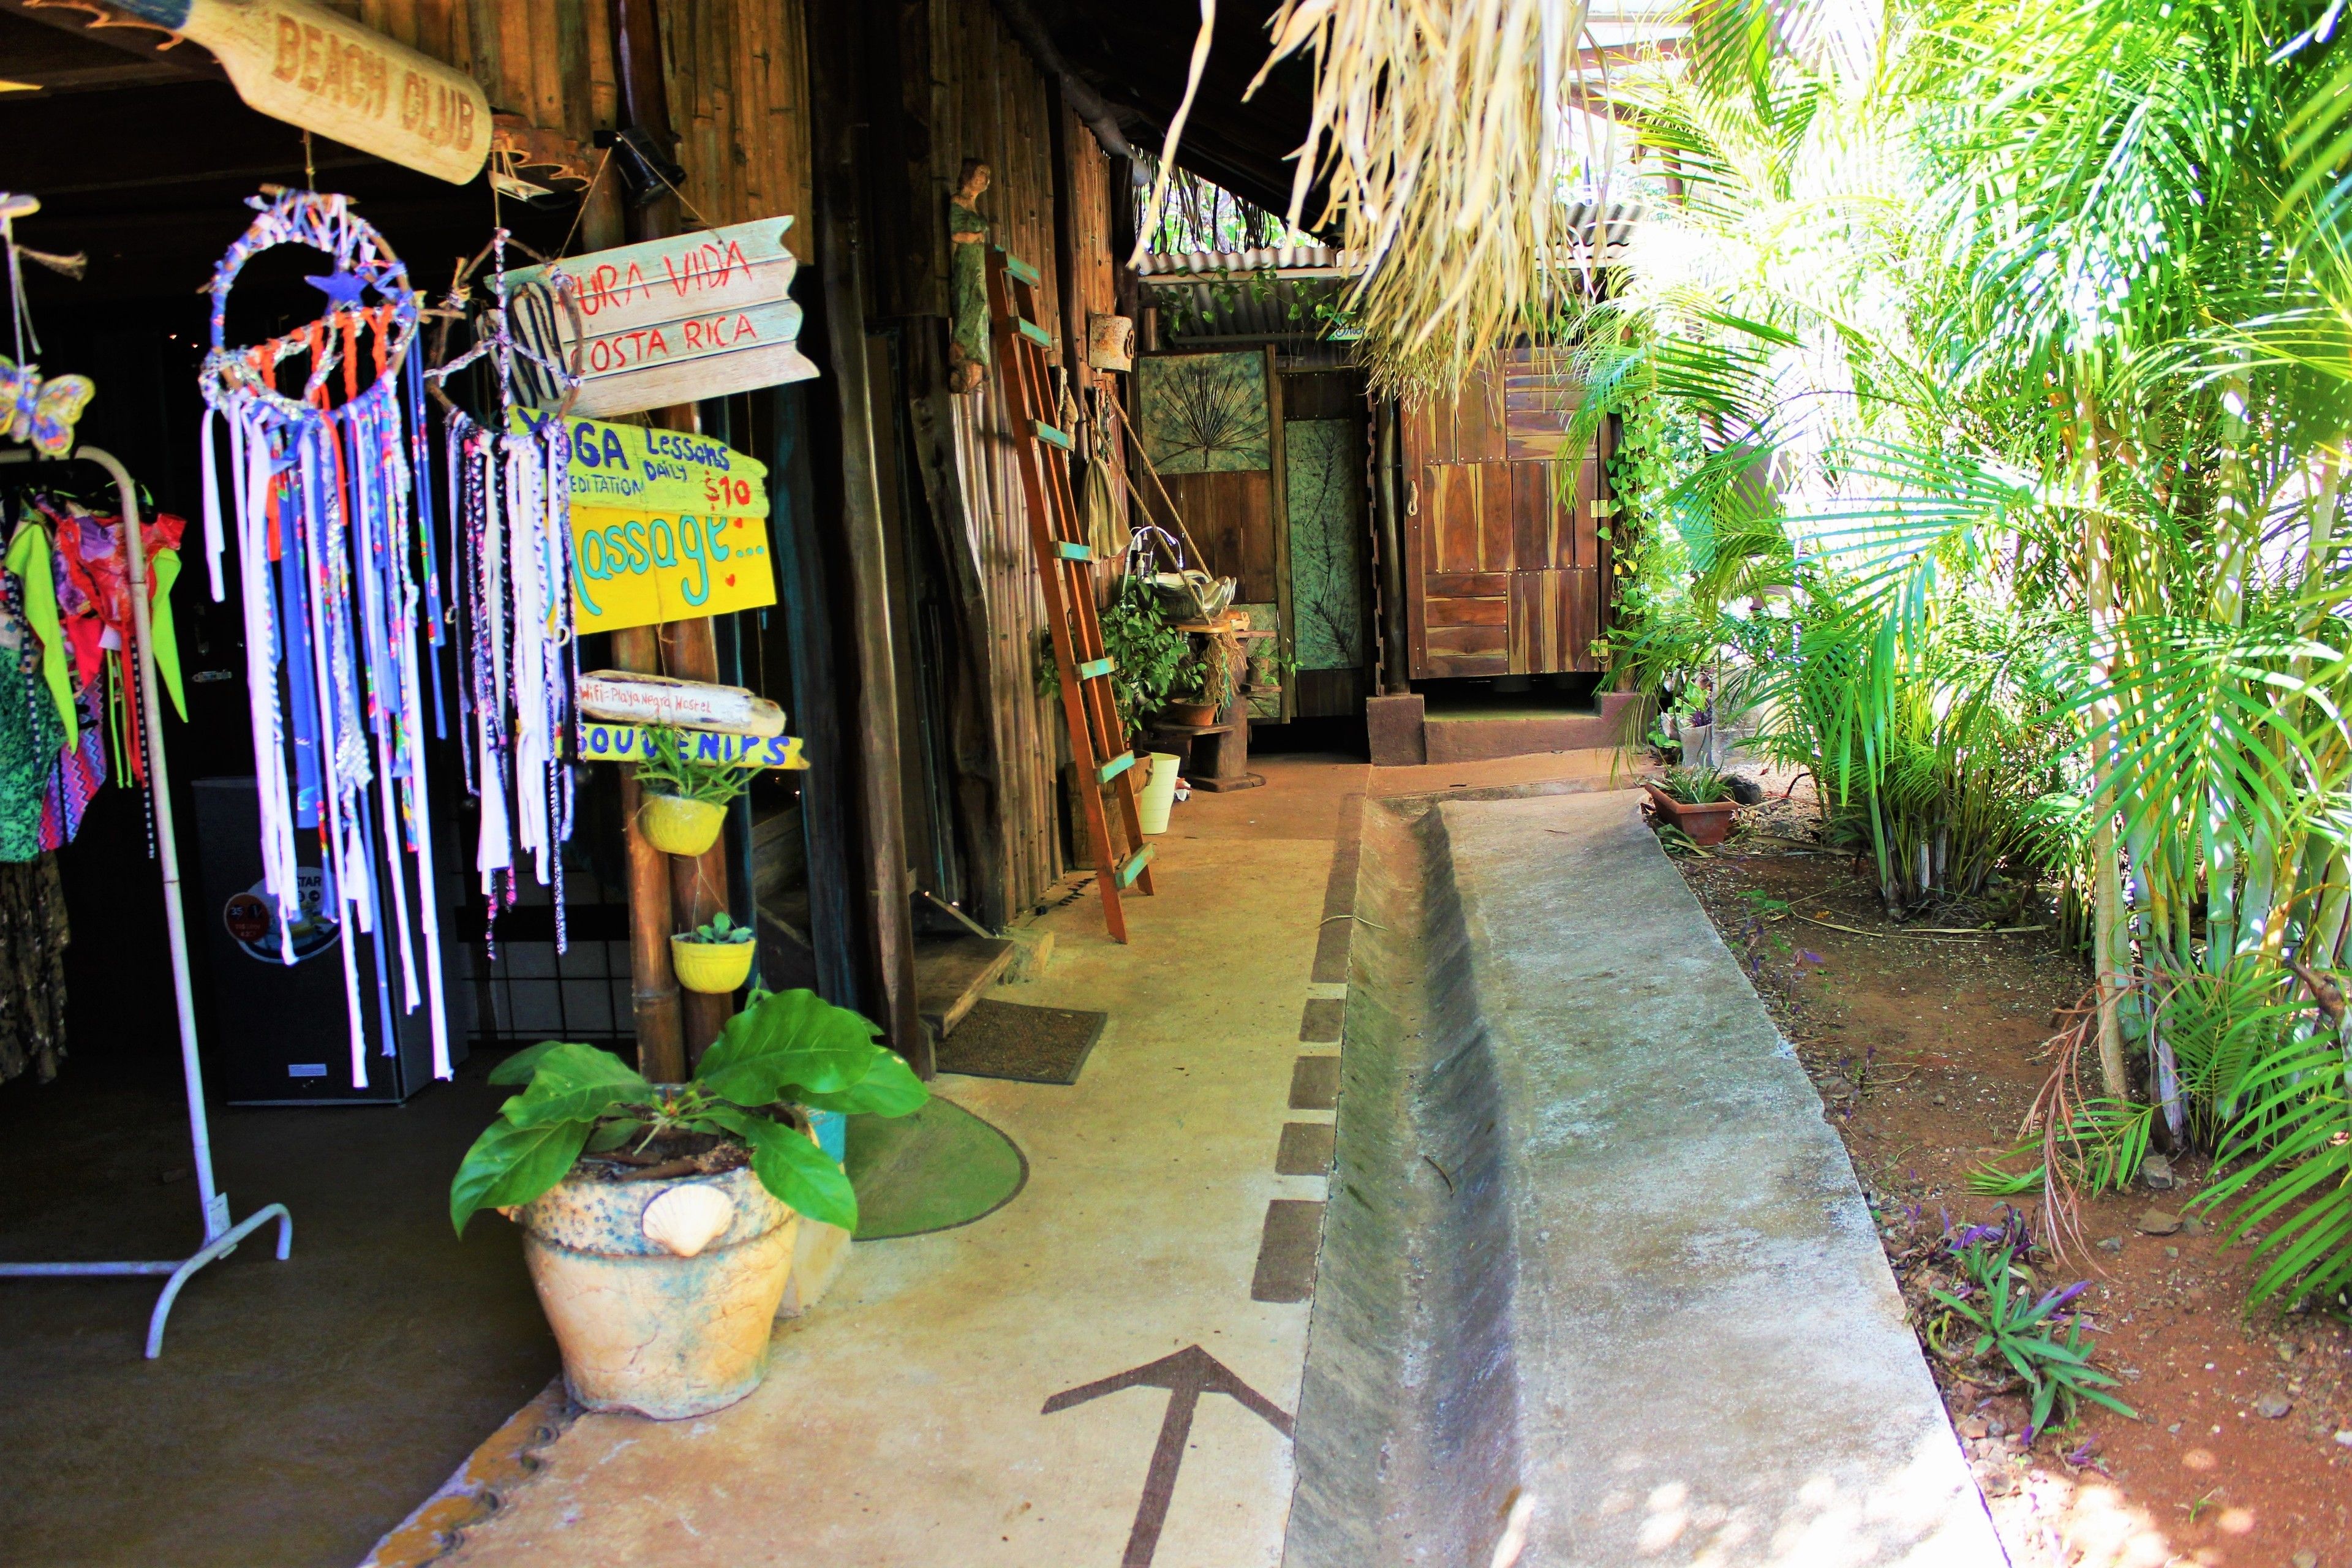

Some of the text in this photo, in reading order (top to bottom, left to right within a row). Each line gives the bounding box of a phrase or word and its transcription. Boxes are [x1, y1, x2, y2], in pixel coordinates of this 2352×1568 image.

[273, 13, 474, 152] BEACH CLUB
[559, 240, 753, 319] PURA VIDA
[683, 314, 757, 351] RICA
[568, 473, 644, 496] EDiTATiON
[703, 470, 751, 511] $10
